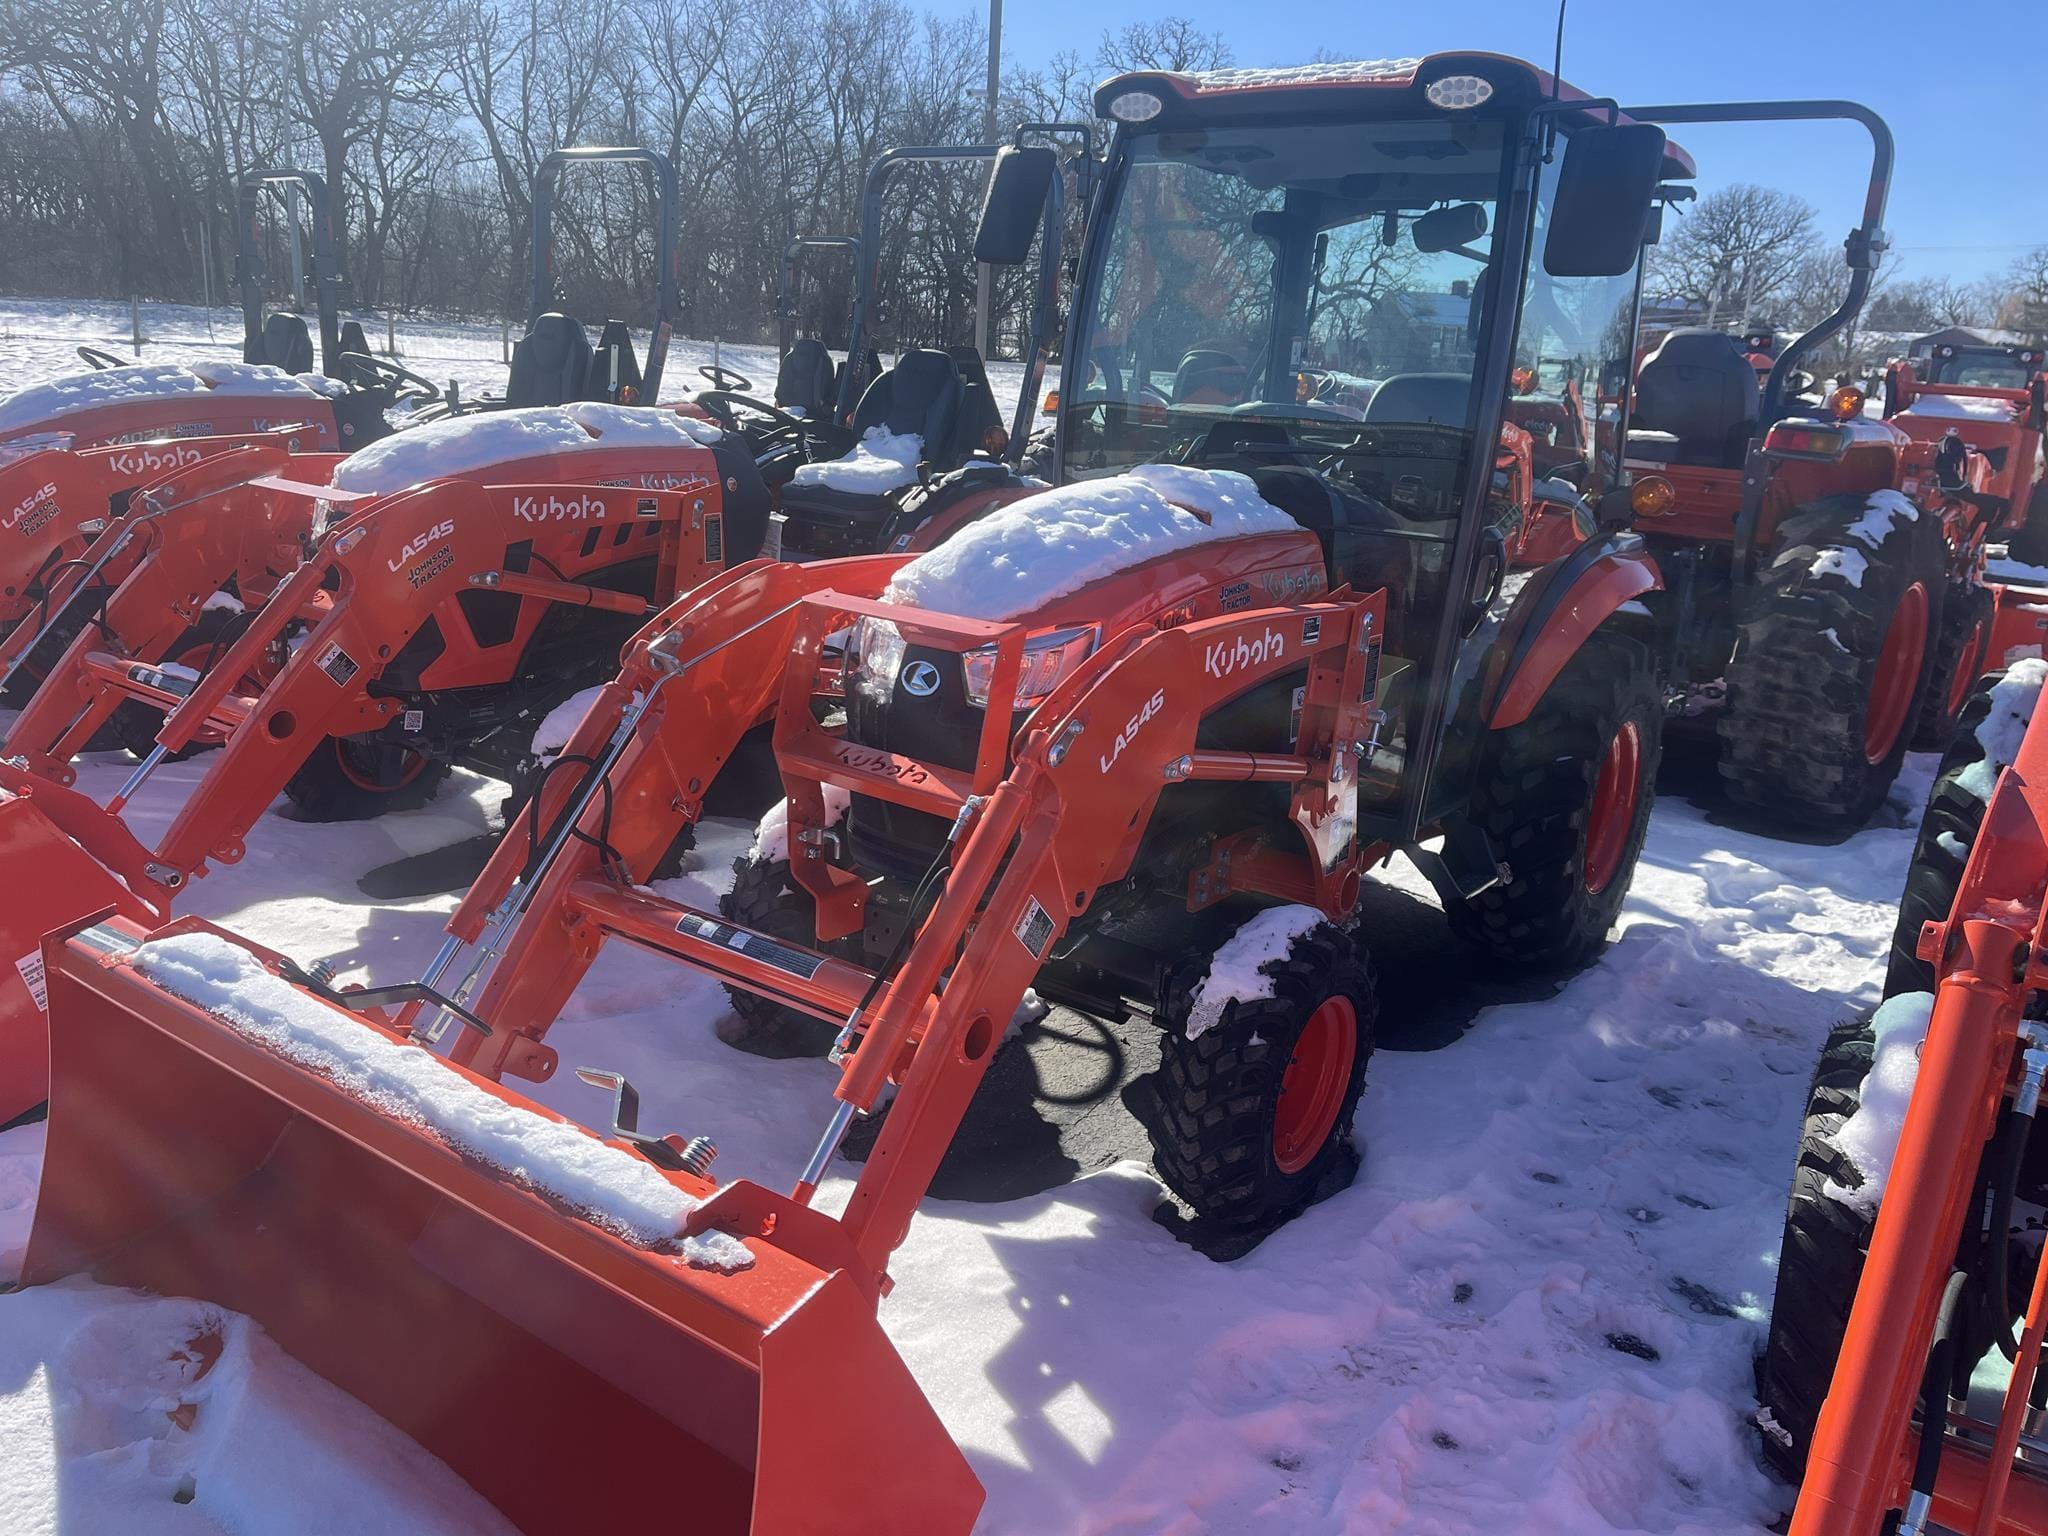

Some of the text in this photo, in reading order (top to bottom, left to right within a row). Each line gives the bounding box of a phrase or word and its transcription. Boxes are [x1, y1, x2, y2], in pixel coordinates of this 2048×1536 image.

[175, 423, 212, 433] JOHNSON
[109, 446, 201, 475] Kubota
[640, 472, 710, 490] Kubota
[1, 482, 57, 529] LA545
[19, 499, 54, 531] JOHNSON
[23, 507, 60, 536] TRACTOR
[514, 495, 605, 522] Kubota
[387, 519, 454, 572] LA545
[408, 545, 450, 580] JOHNSON
[411, 555, 455, 590] TRACTOR
[1219, 583, 1249, 599] JOHNSON
[1263, 566, 1321, 600] Kubota
[1221, 595, 1251, 612] TRACTOR
[1204, 627, 1284, 678] Kubota
[1100, 688, 1164, 774] LA545
